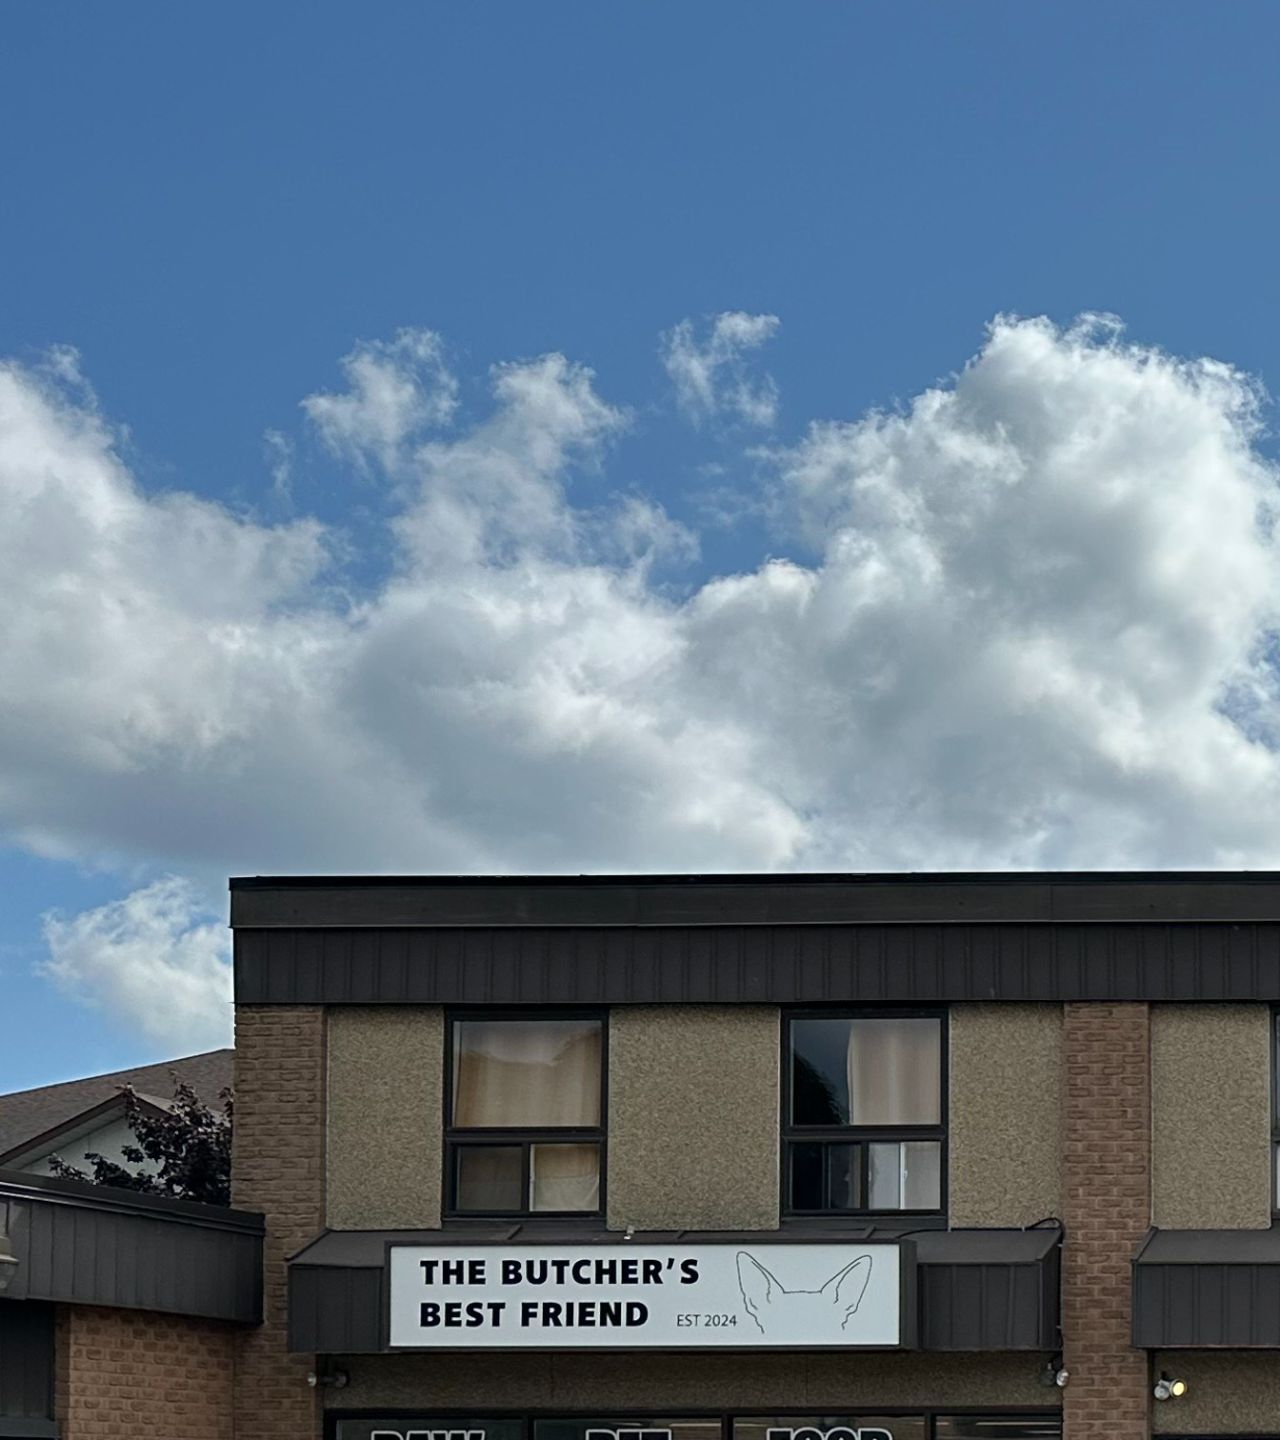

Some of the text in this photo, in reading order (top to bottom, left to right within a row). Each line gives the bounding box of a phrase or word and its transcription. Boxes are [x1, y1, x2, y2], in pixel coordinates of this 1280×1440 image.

[420, 1258, 699, 1285] THE BUTCHER'S
[420, 1302, 648, 1327] BEST FRIEND
[677, 1314, 737, 1327] EST 2024
